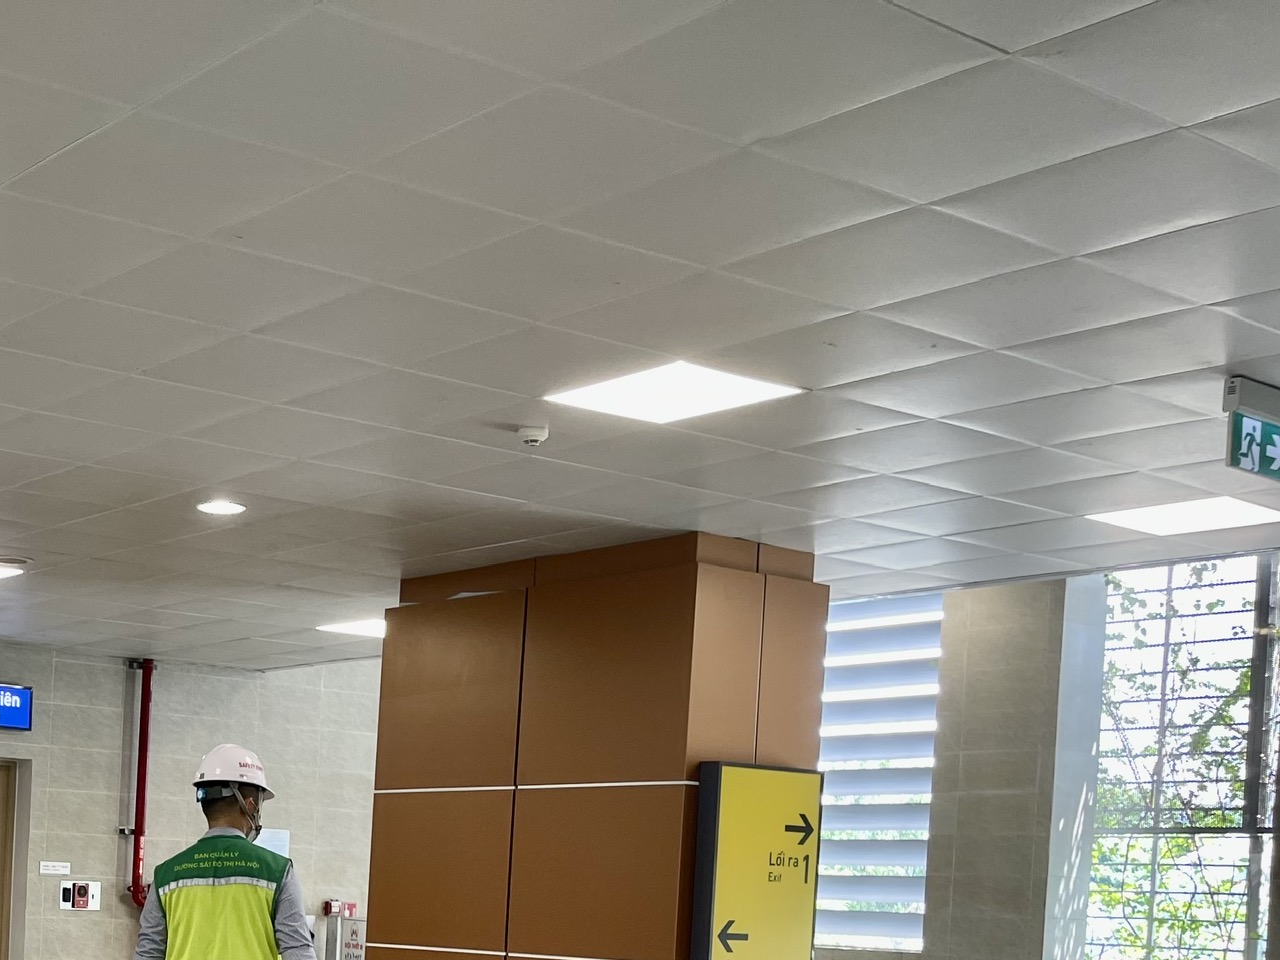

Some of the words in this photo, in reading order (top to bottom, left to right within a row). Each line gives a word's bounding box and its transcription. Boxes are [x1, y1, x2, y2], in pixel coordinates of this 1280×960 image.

[768, 872, 782, 883] Exit
[769, 851, 785, 867] Lối
[788, 856, 799, 867] ra
[802, 854, 810, 884] 1
